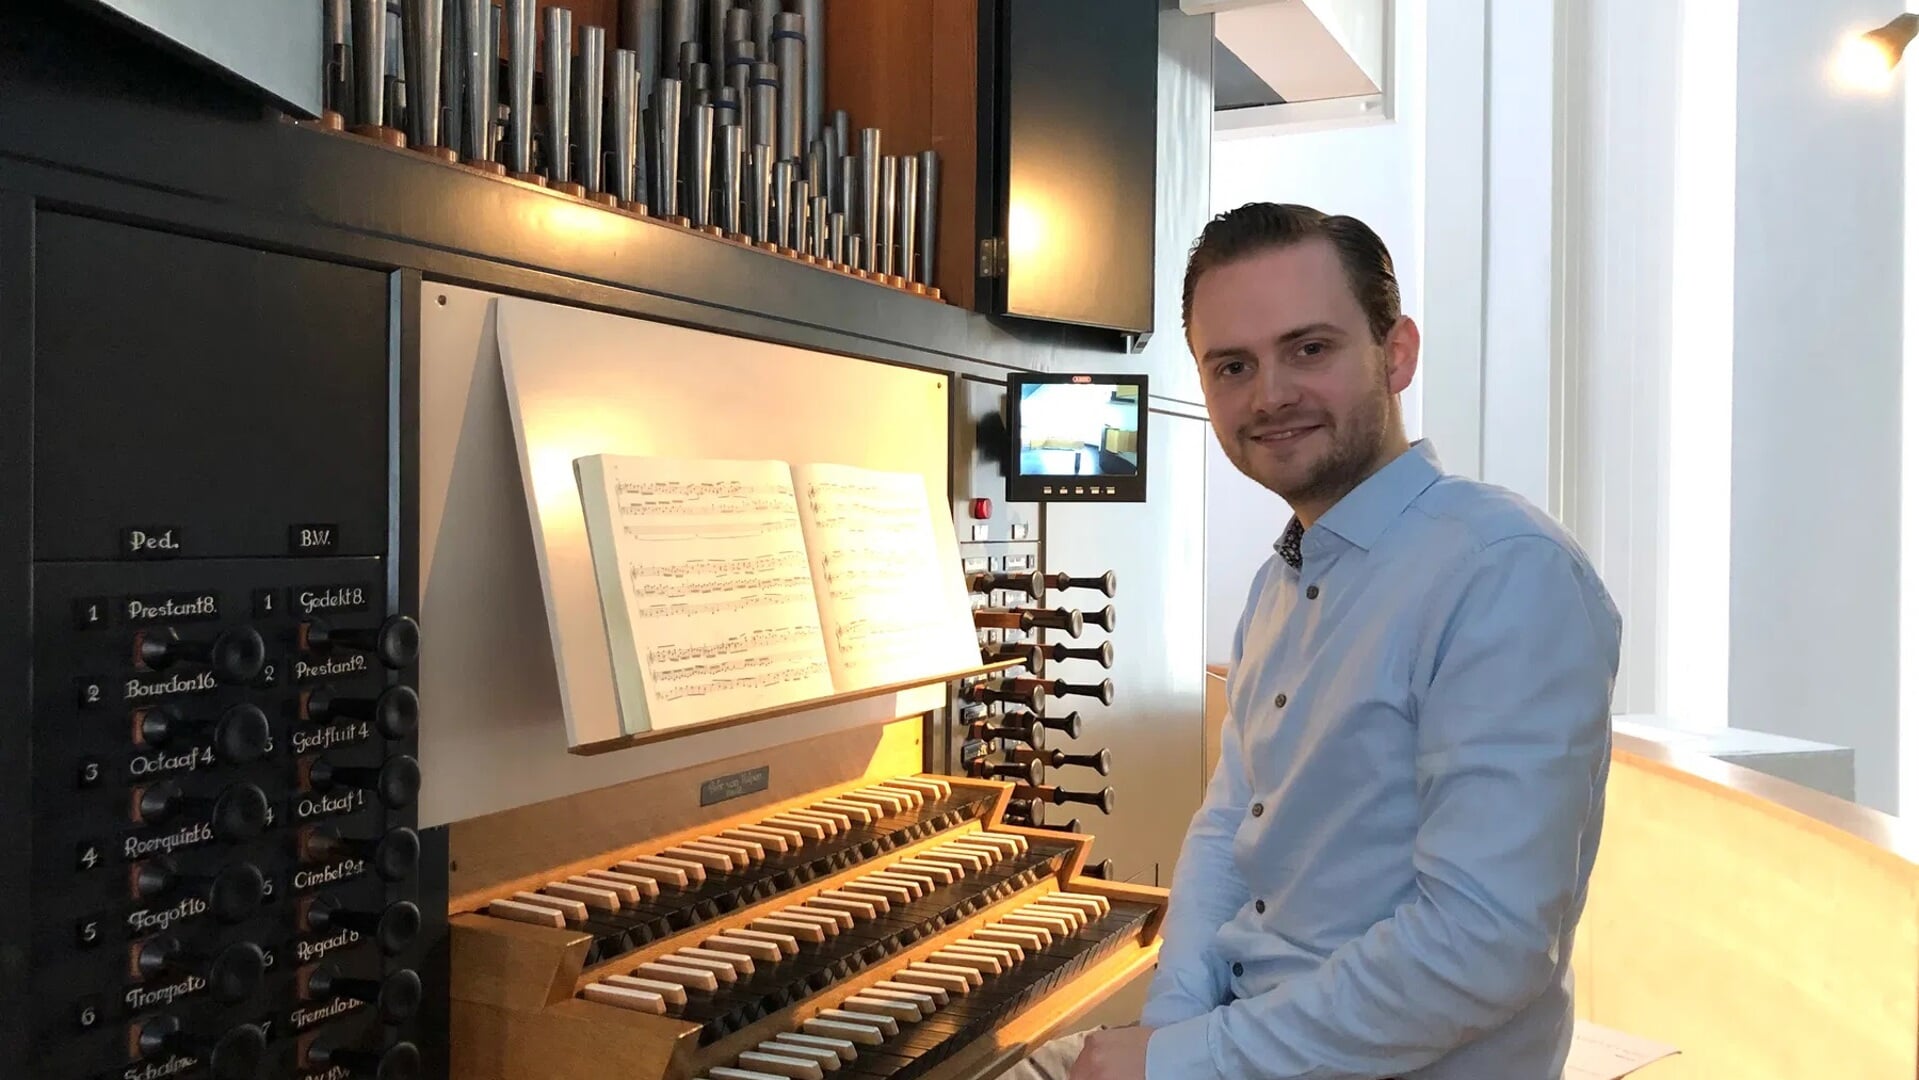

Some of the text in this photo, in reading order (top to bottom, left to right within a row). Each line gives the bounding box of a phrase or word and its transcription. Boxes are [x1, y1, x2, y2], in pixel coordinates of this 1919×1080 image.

[130, 529, 180, 551] Ped.
[301, 529, 332, 547] B.W.
[263, 593, 273, 610] 1
[88, 604, 99, 622] 1
[264, 665, 275, 681] 2
[87, 684, 100, 702] 2
[130, 746, 200, 775] Octaaf
[84, 763, 99, 781] 3
[81, 846, 98, 870] 4
[83, 922, 97, 942] 5
[81, 1006, 96, 1026] 6
